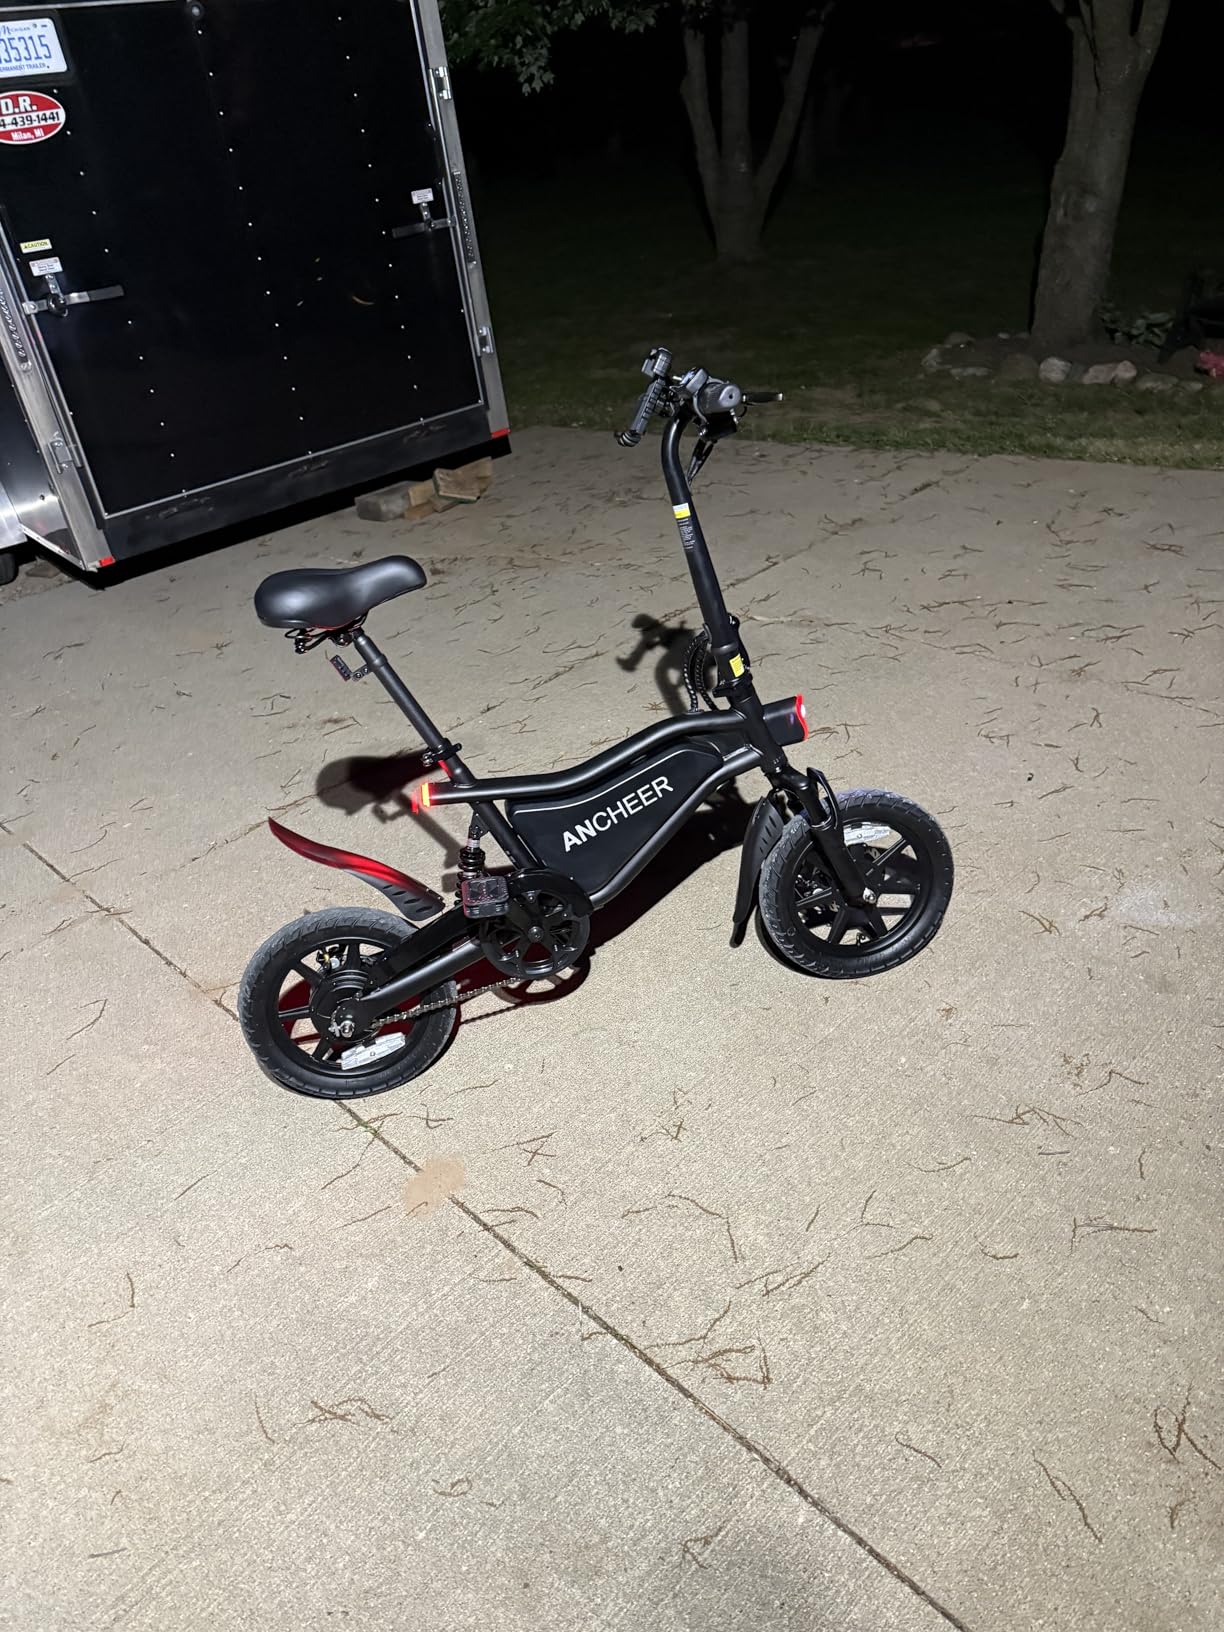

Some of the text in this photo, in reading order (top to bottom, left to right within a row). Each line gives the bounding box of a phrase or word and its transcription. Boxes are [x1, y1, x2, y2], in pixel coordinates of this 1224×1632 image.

[0, 35, 52, 64] 35315
[27, 241, 48, 249] CAUTION
[563, 776, 674, 853] ANCHEER
